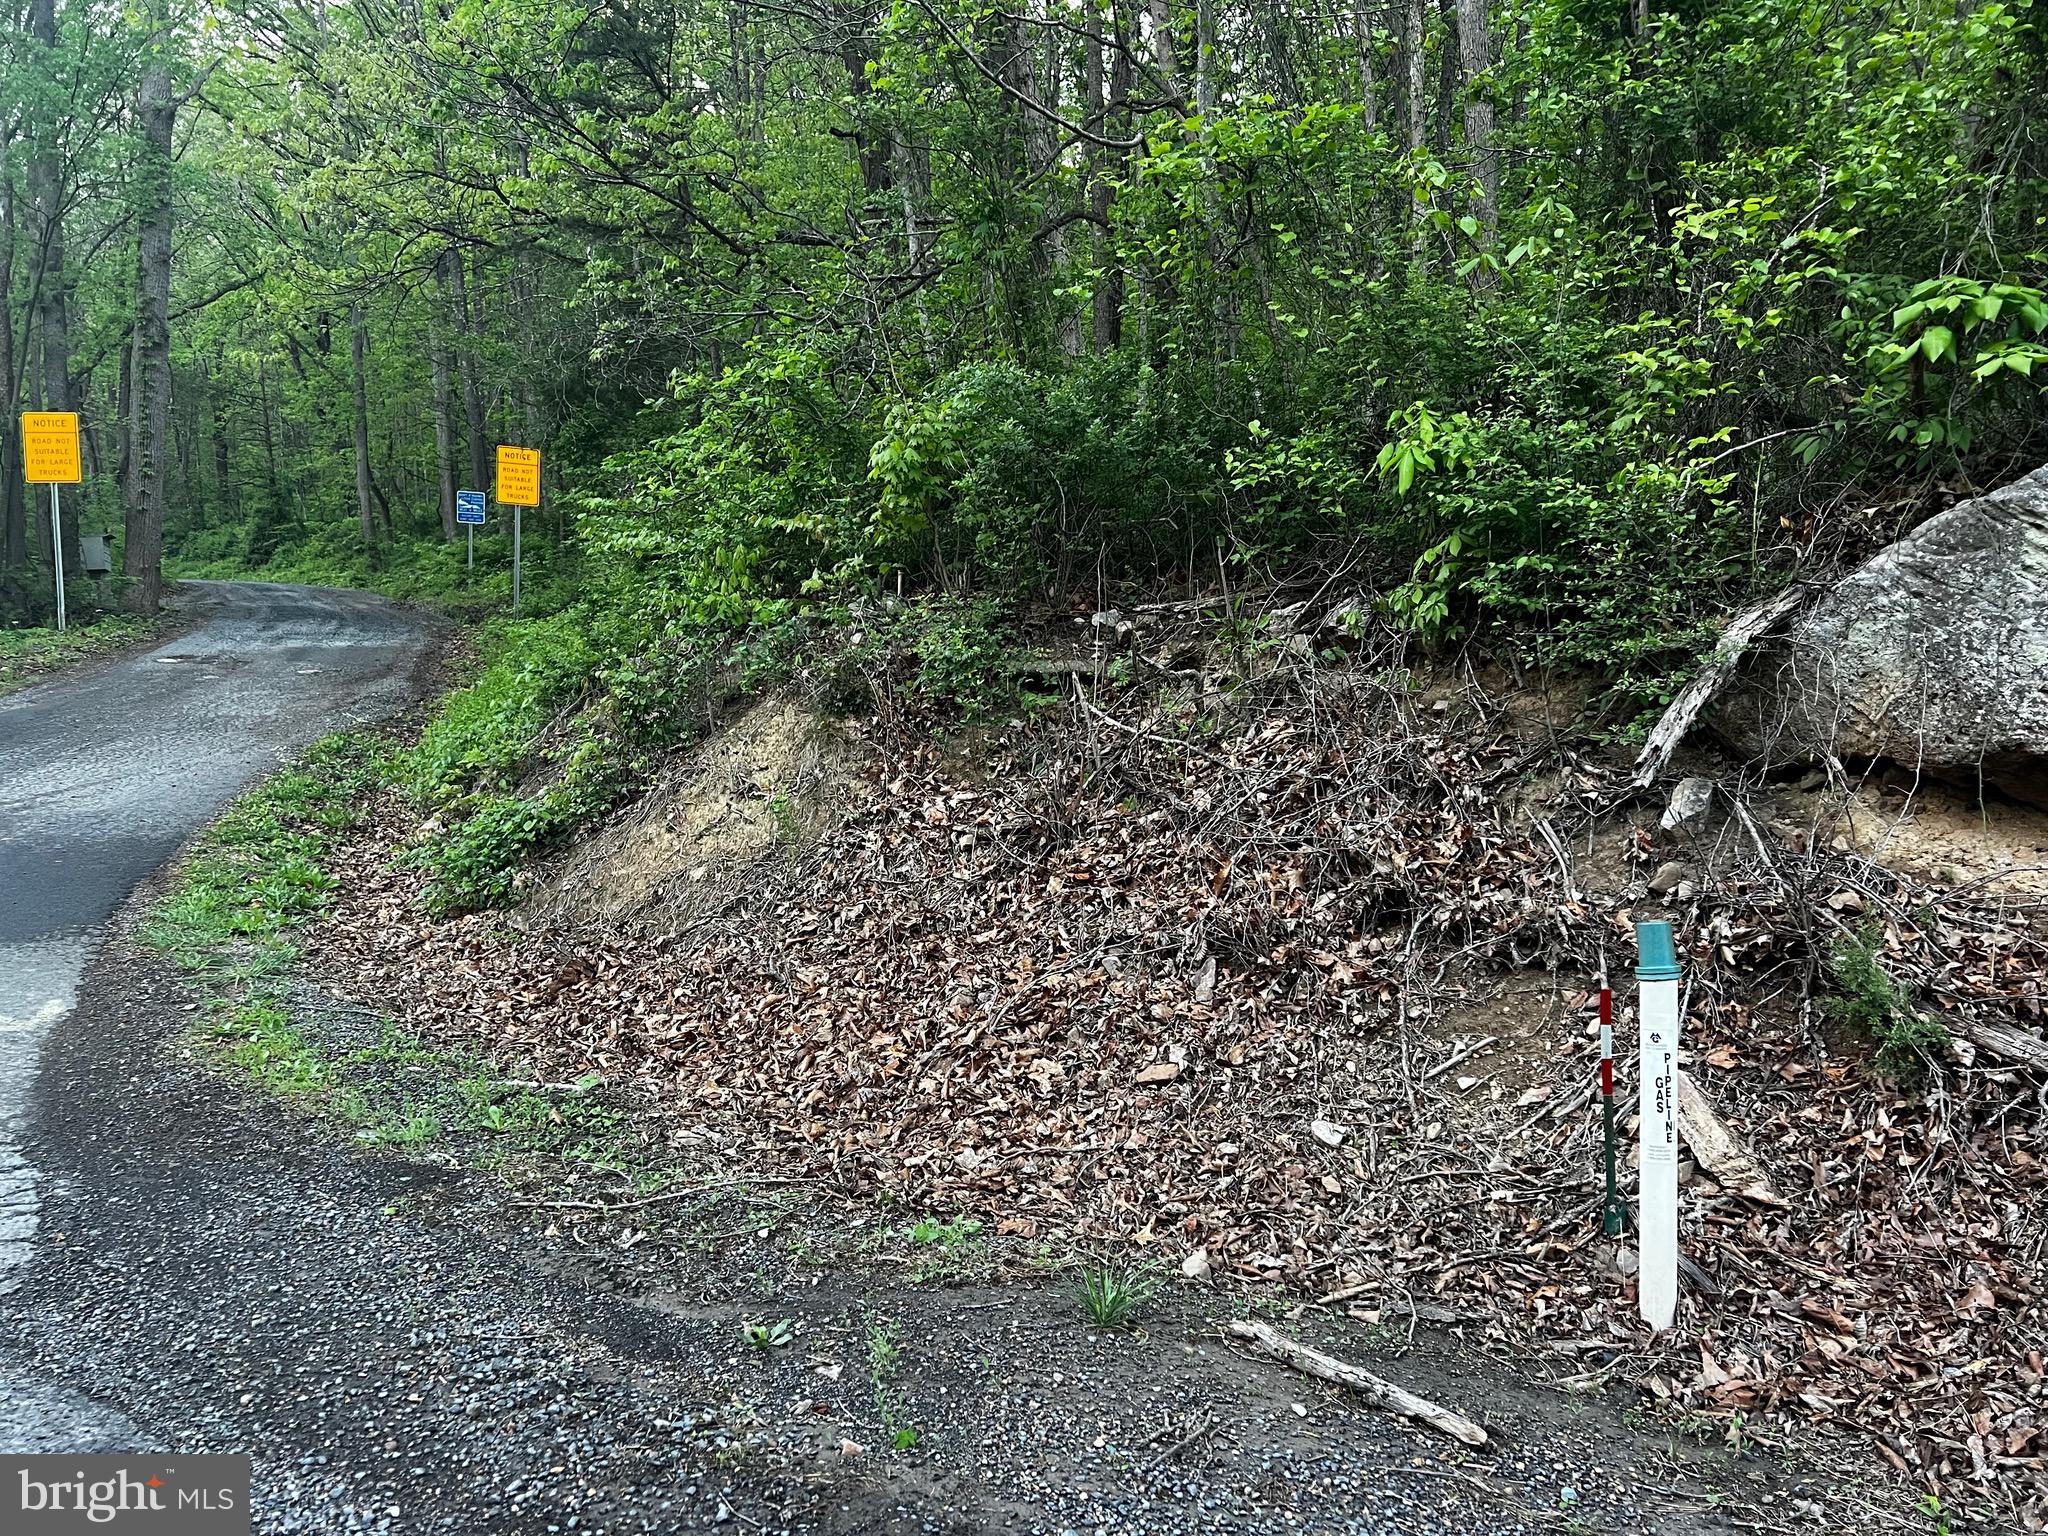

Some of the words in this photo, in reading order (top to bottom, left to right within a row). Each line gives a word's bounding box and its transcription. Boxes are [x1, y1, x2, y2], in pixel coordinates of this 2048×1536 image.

[33, 419, 67, 428] NOTICE
[505, 452, 532, 460] NOTICE
[1655, 1076, 1664, 1114] GAS
[1664, 1052, 1673, 1144] PIPELINE
